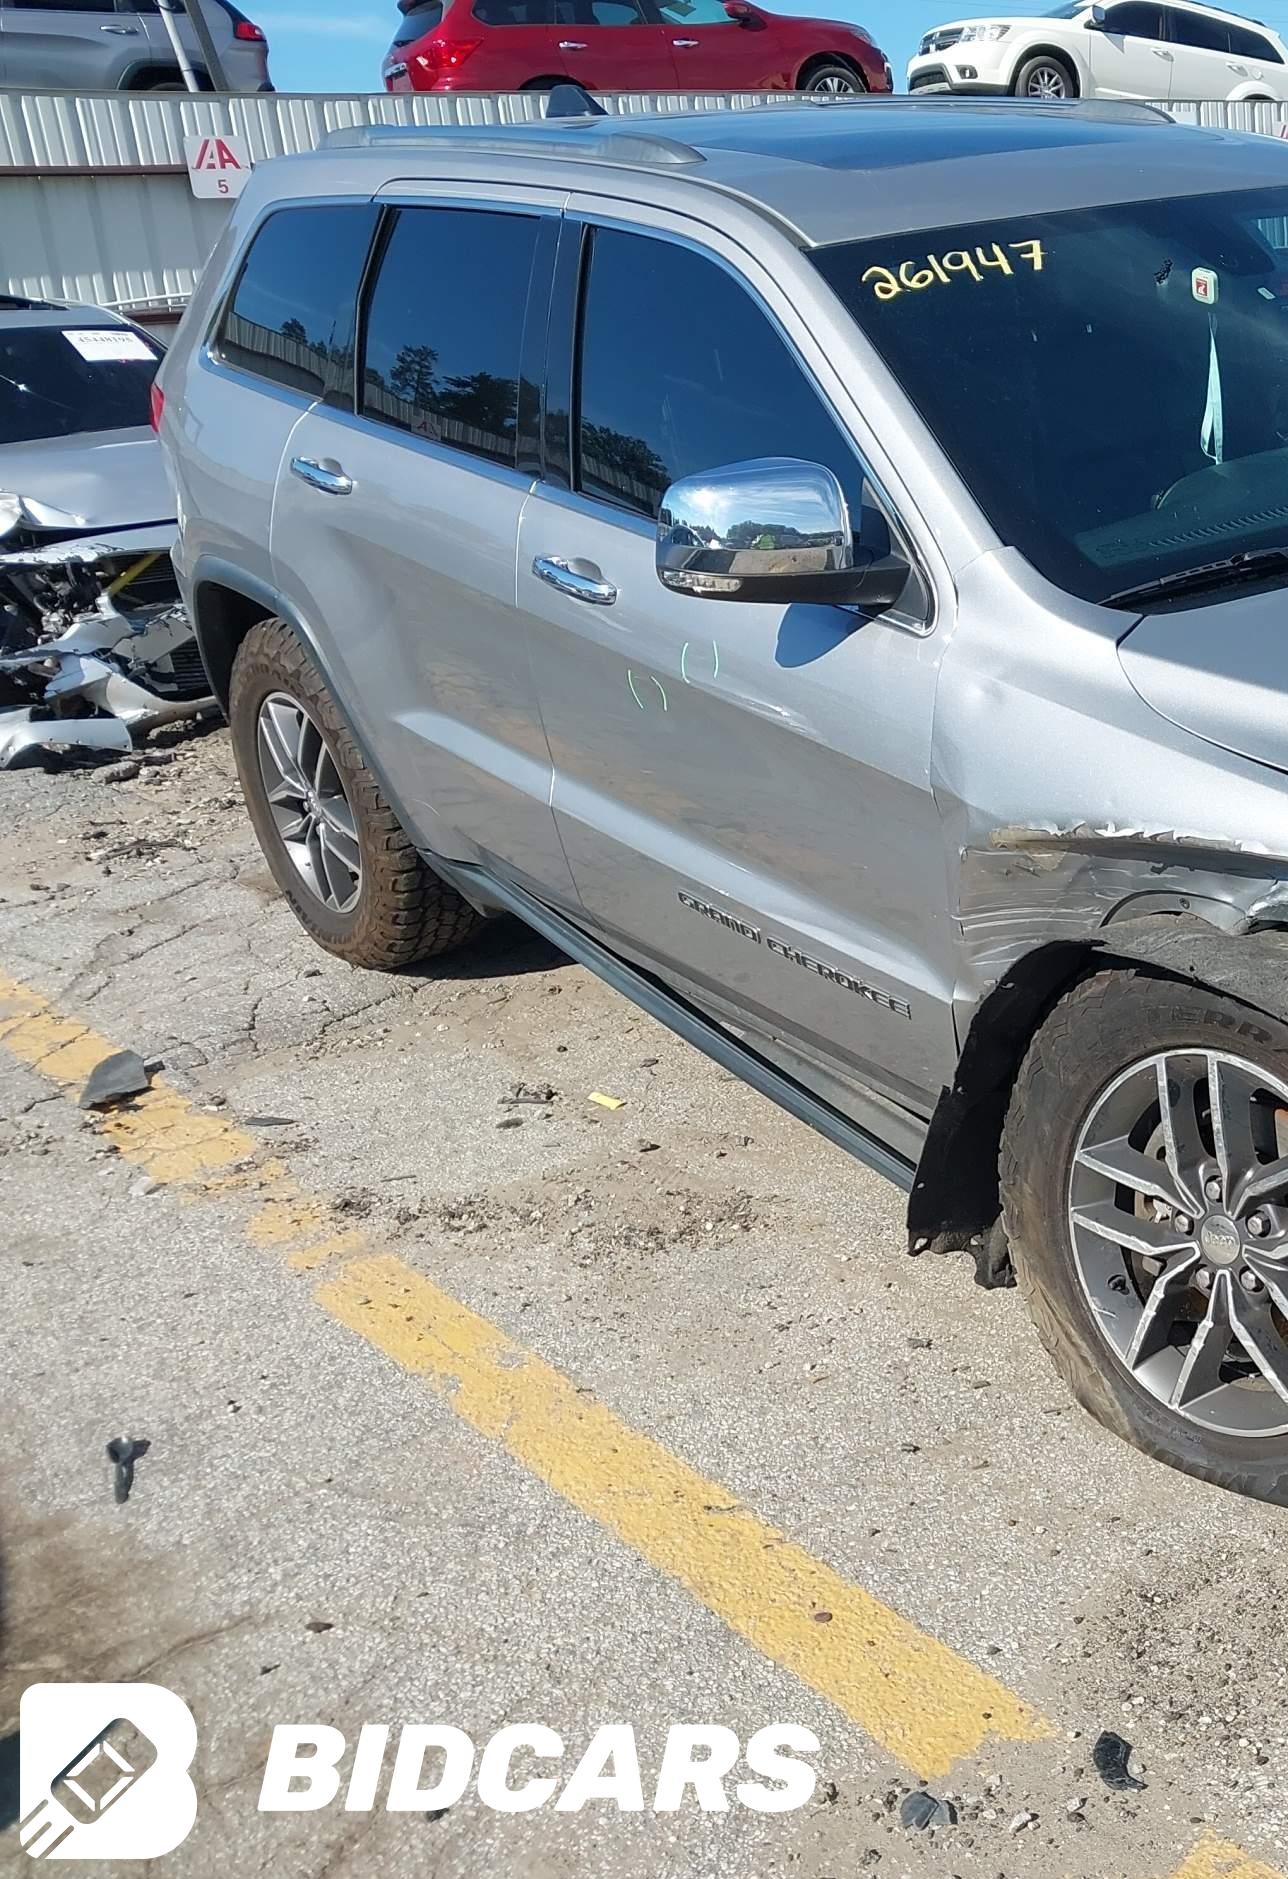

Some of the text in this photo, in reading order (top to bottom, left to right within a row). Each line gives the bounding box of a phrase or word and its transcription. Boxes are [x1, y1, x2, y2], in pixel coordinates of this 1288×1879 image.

[217, 179, 229, 194] 5
[861, 239, 1048, 300] 261947
[678, 889, 913, 1020] GRAND CHEROKEE
